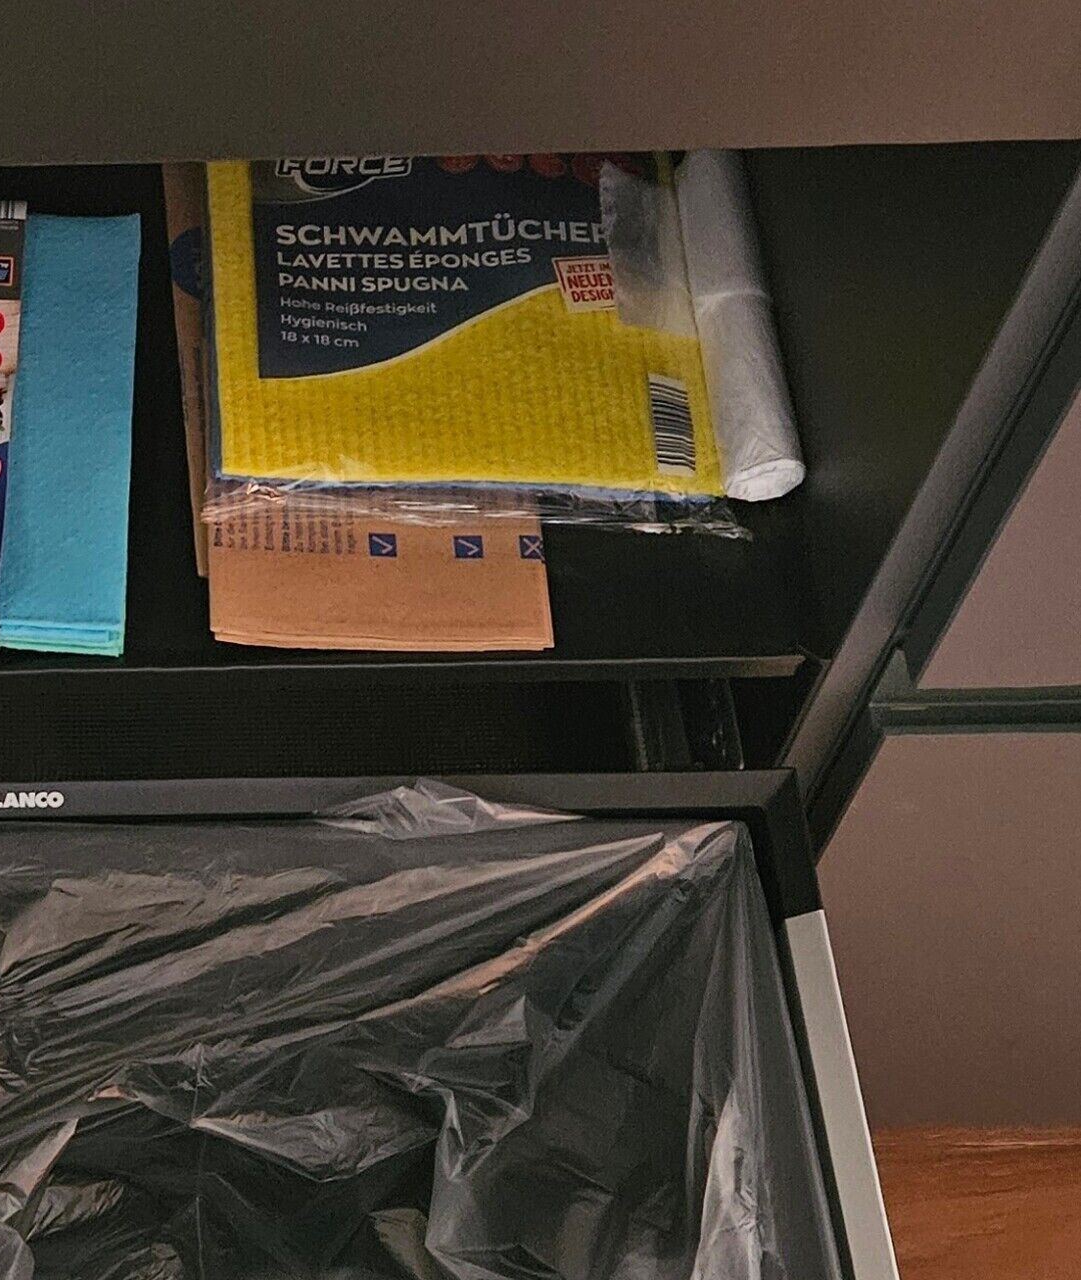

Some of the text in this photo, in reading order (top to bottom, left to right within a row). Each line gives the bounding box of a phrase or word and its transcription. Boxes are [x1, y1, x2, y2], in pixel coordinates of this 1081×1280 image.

[282, 156, 407, 176] FORCE
[276, 247, 532, 269] LAVETTES ÉPONGES
[566, 263, 596, 274] JETZT
[278, 272, 470, 293] PANNI SPUGNA
[280, 296, 438, 316] Hohe Reißfestigkeit
[280, 314, 368, 332] Hygienisch
[280, 330, 360, 348] 18 x 18 cm
